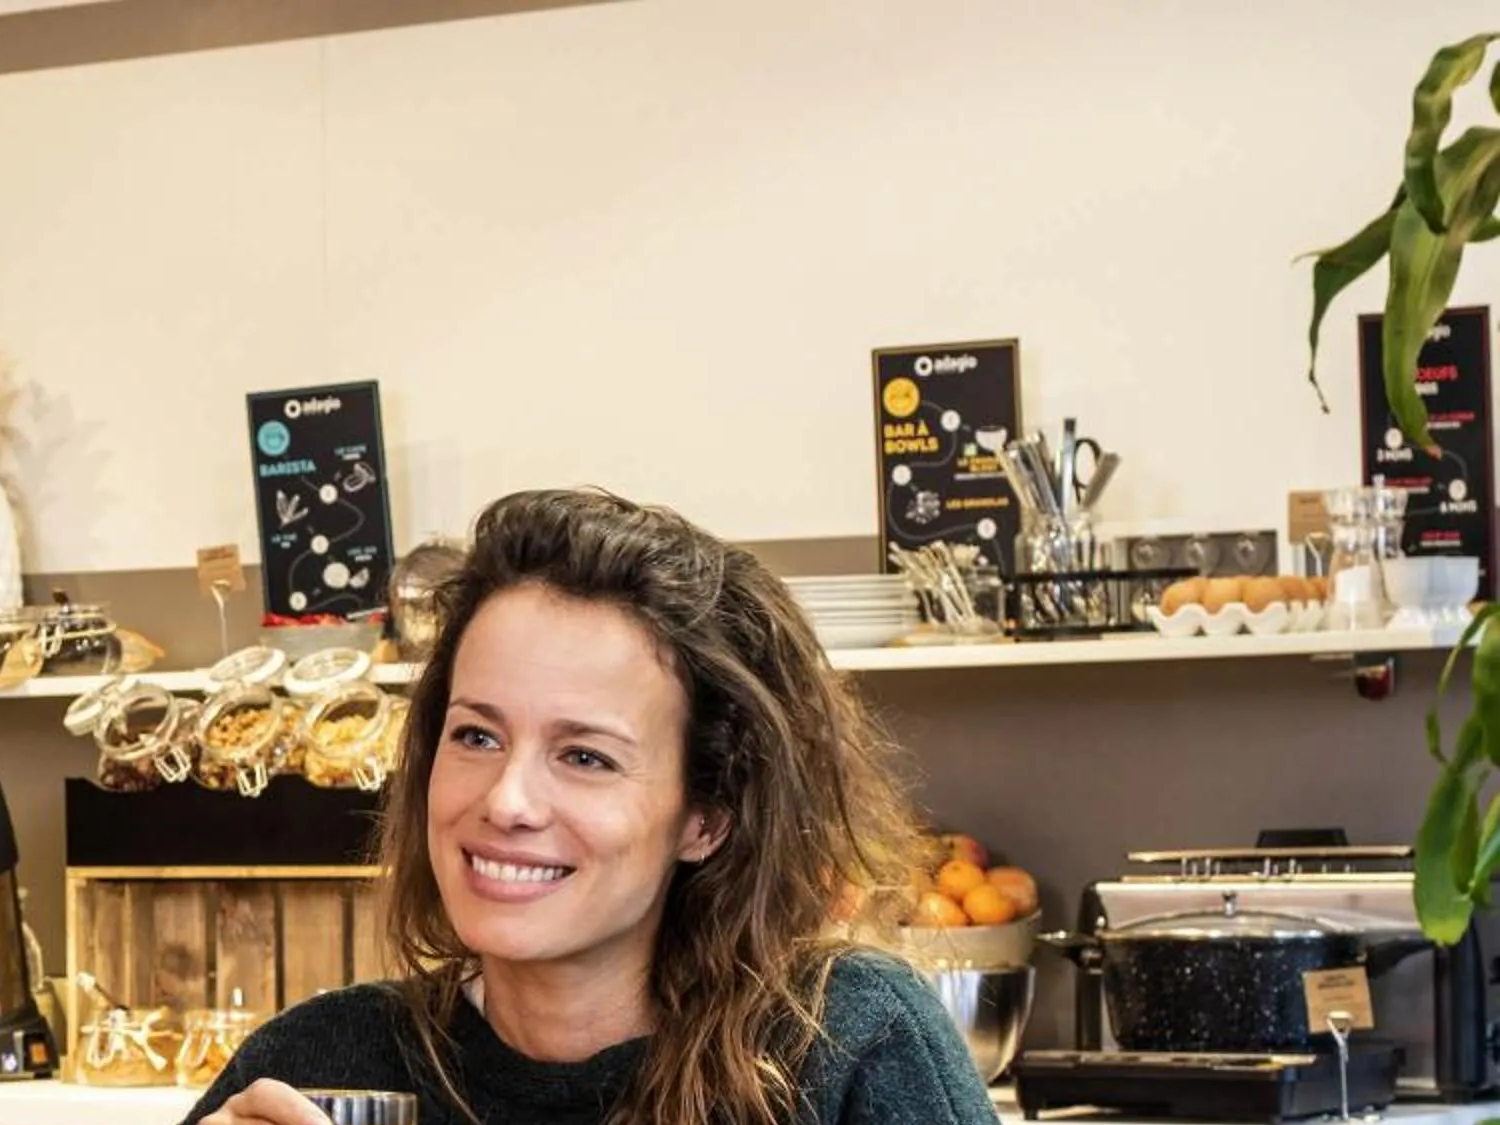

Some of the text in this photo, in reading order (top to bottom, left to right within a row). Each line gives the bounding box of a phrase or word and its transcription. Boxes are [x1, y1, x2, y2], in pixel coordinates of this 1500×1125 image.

[884, 423, 915, 438] BAR
[884, 437, 939, 454] BOWLS
[259, 459, 316, 477] BARISTA
